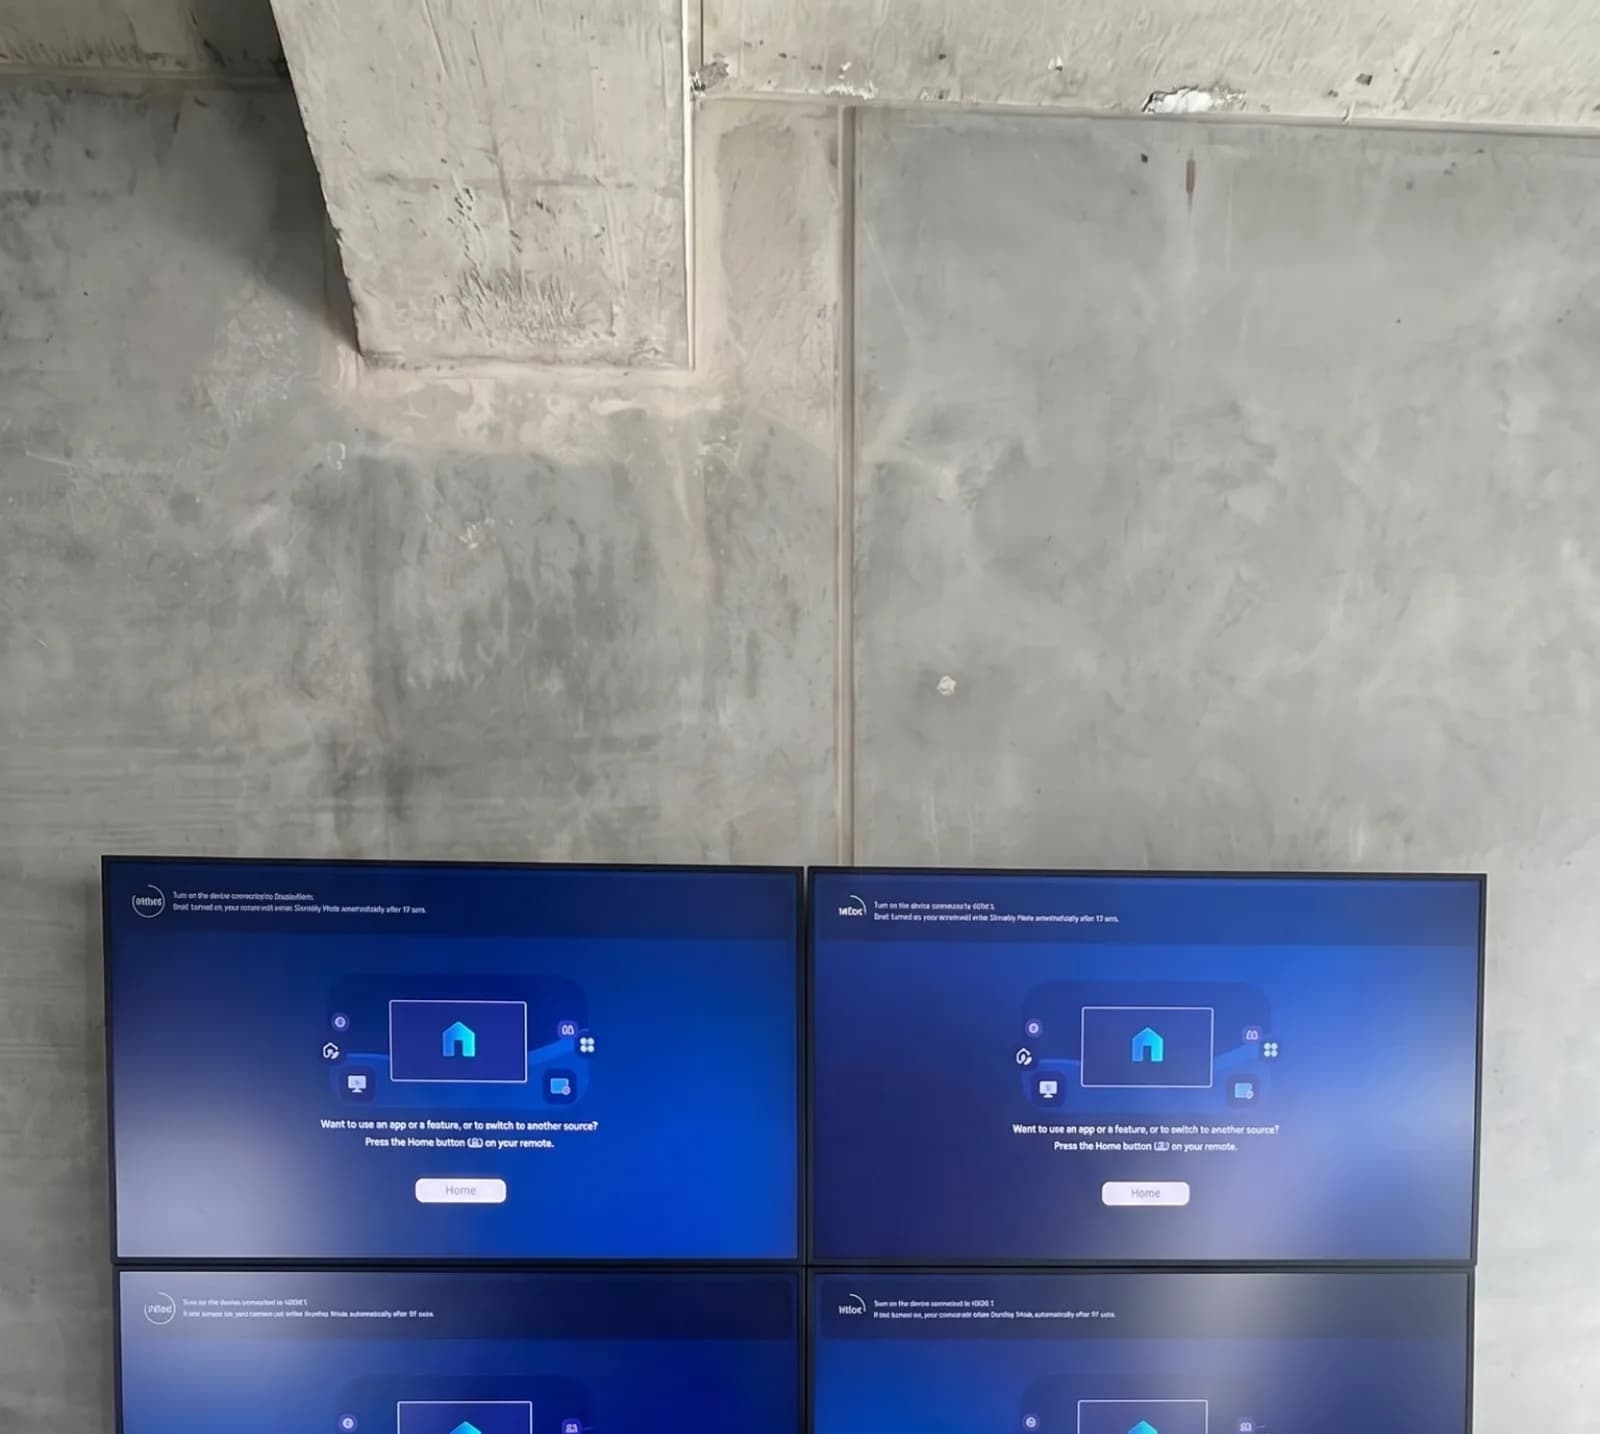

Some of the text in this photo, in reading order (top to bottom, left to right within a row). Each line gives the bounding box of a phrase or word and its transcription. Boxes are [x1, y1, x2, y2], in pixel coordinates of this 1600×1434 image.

[320, 1119, 345, 1129] Want
[346, 1120, 356, 1129] to
[358, 1121, 374, 1129] use
[376, 1121, 387, 1129] an
[389, 1121, 406, 1131] app
[407, 1121, 417, 1130] or
[419, 1121, 425, 1130] a
[462, 1122, 472, 1130] or
[473, 1120, 484, 1130] to
[485, 1120, 514, 1131] switch
[515, 1121, 525, 1131] to
[526, 1120, 561, 1131] another
[1037, 1124, 1047, 1134] to
[1048, 1126, 1064, 1134] use
[1066, 1125, 1076, 1134] an
[1078, 1126, 1095, 1136] app
[1096, 1126, 1106, 1134] or
[1107, 1125, 1113, 1134] a
[1149, 1126, 1158, 1134] or
[1160, 1125, 1169, 1134] to
[1200, 1126, 1209, 1134] to
[365, 1137, 389, 1147] Press
[390, 1137, 406, 1147] the
[407, 1137, 434, 1147] Home
[435, 1137, 465, 1147] button
[484, 1139, 496, 1148] on
[497, 1139, 518, 1150] your
[1054, 1140, 1077, 1151] Press
[1078, 1141, 1093, 1151] the
[1095, 1141, 1121, 1151] Home
[1122, 1141, 1151, 1151] button
[1171, 1143, 1182, 1151] on
[1183, 1143, 1203, 1153] your
[445, 1185, 476, 1195] Home
[1130, 1188, 1160, 1198] Home
